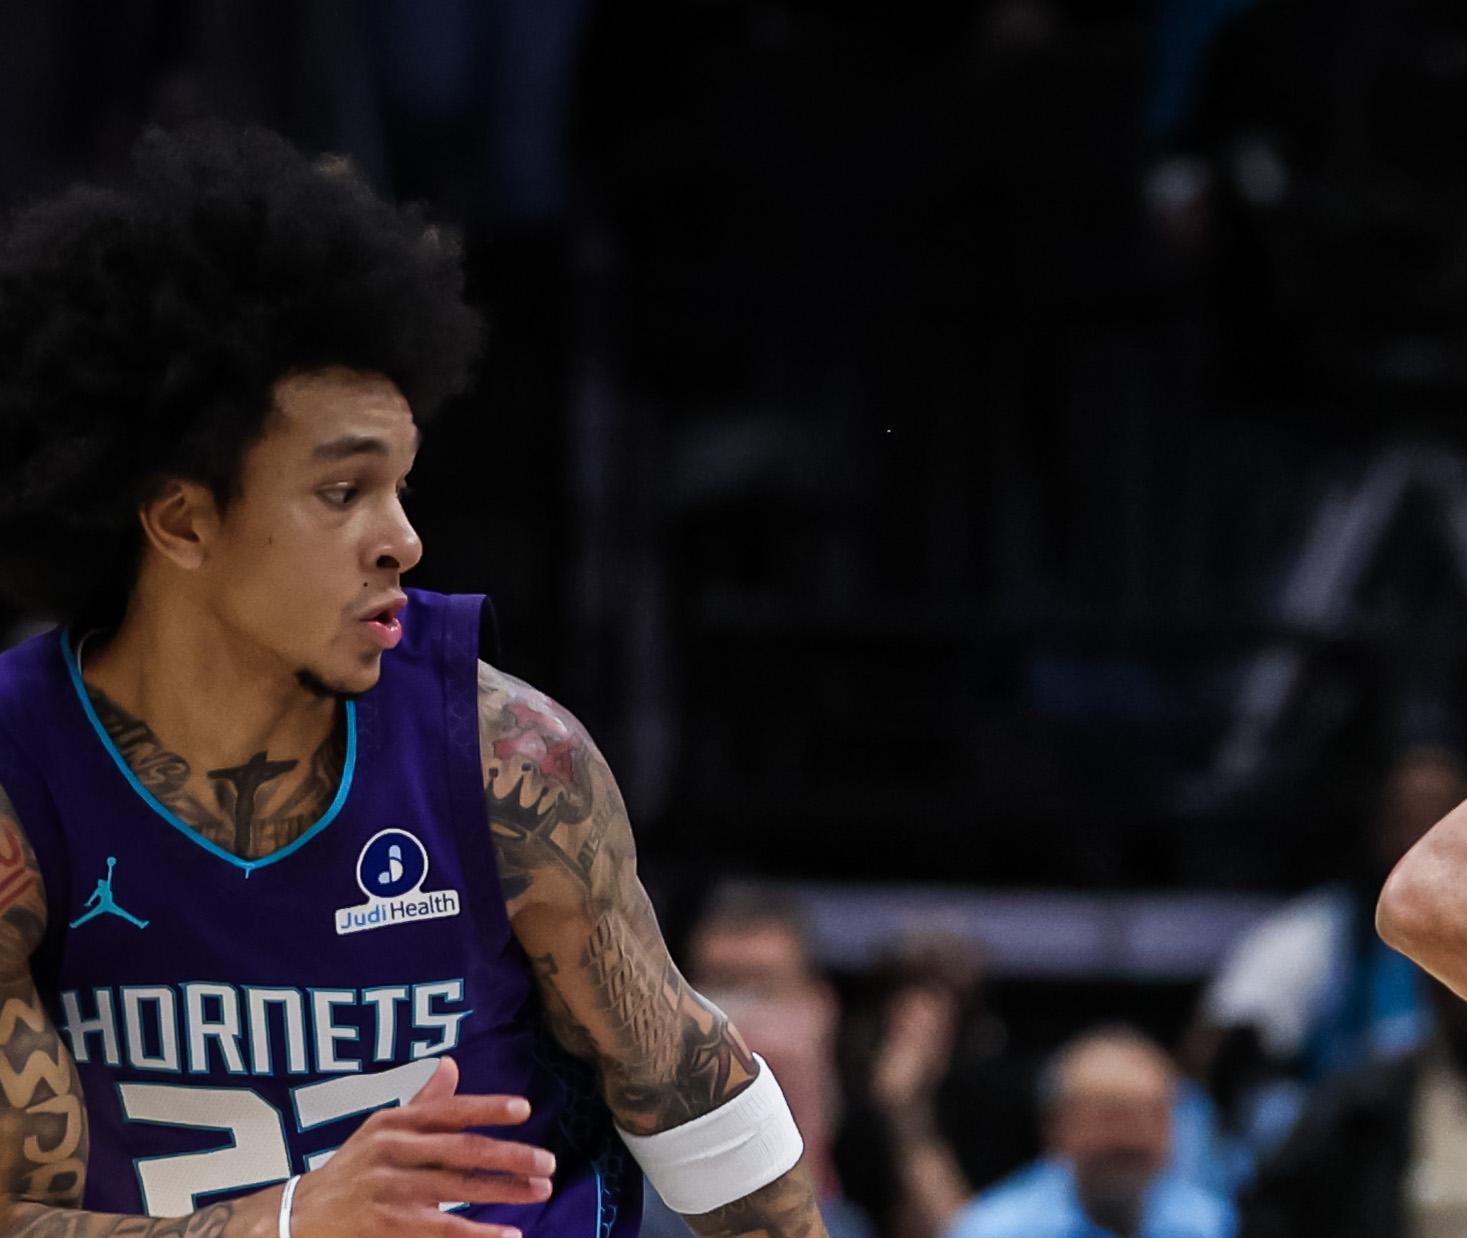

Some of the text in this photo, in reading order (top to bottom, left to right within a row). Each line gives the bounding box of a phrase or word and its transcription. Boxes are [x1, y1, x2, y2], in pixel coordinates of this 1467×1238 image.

[340, 893, 455, 929] Judi Health
[61, 977, 473, 1076] HORNETS
